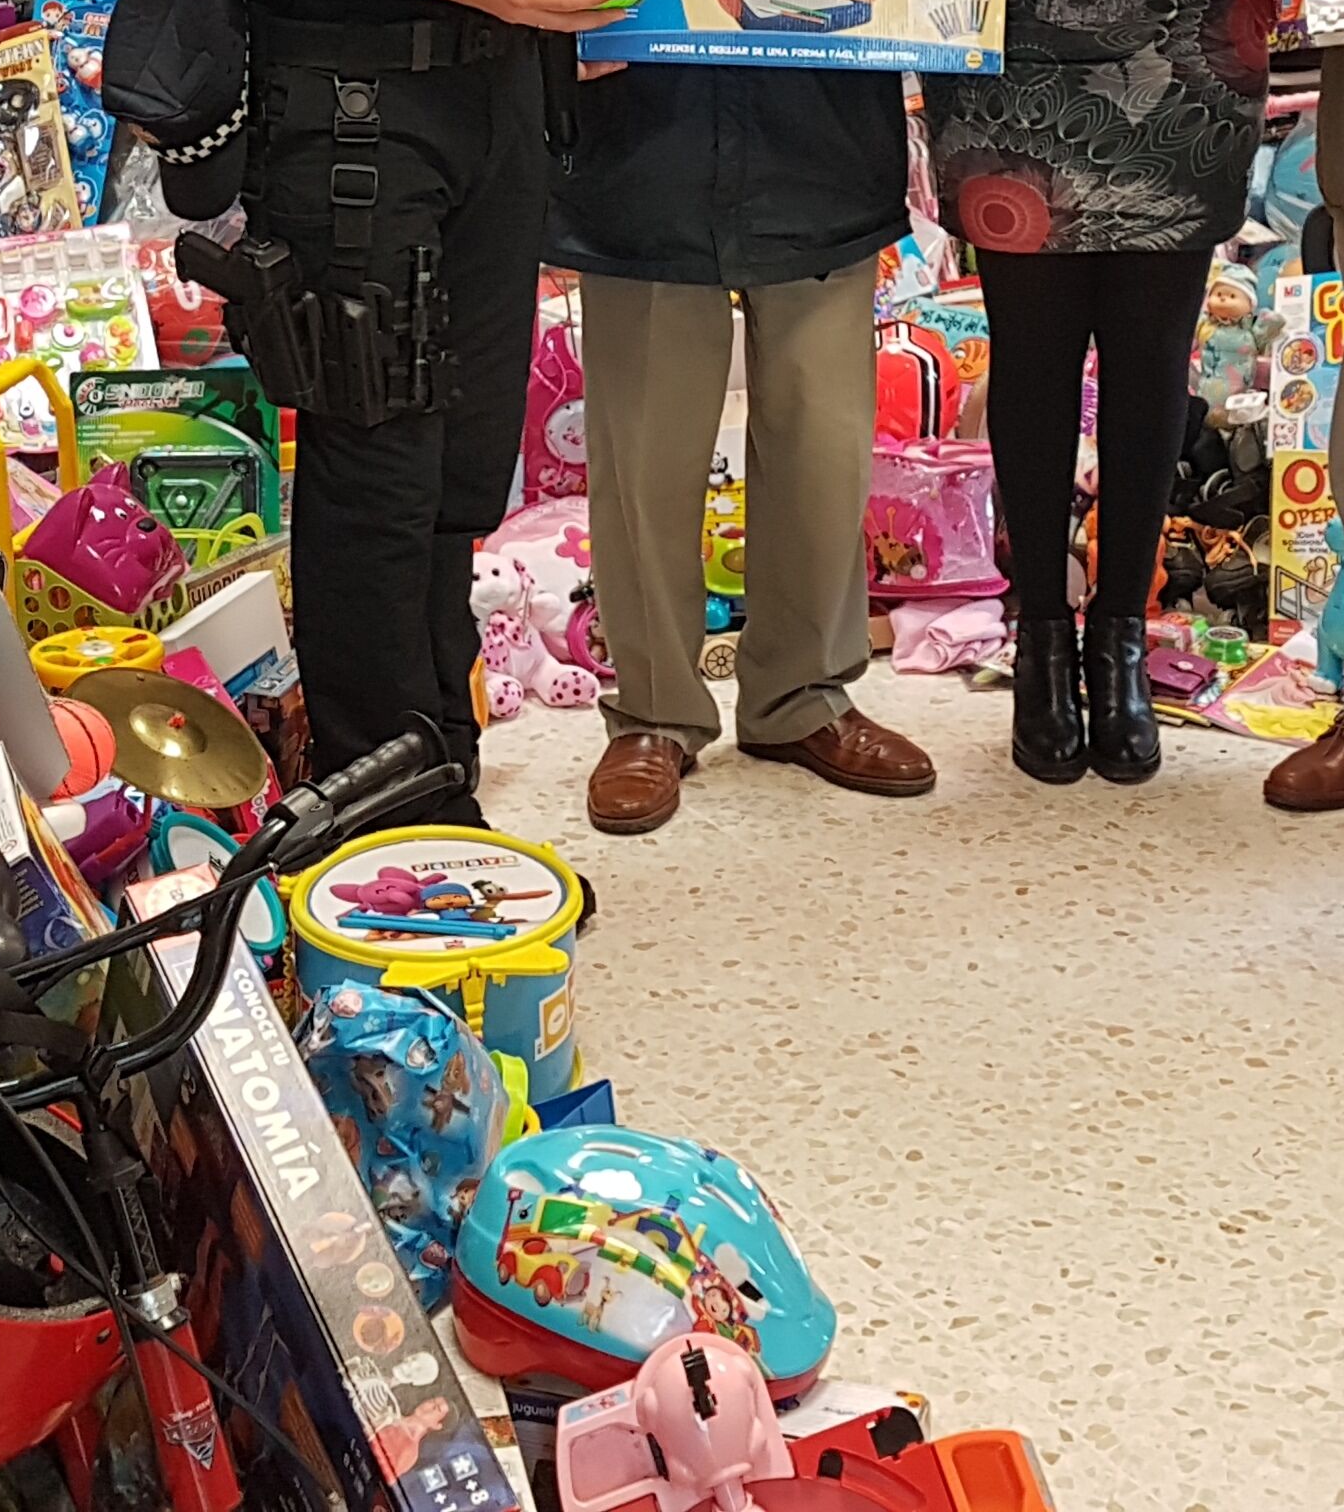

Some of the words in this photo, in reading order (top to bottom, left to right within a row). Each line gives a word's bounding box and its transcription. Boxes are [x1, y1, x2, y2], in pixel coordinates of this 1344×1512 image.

[1284, 285, 1302, 297] MB
[232, 967, 278, 1042] CONOCE
[267, 1041, 292, 1067] TU
[209, 990, 322, 1201] NATOMÍA
